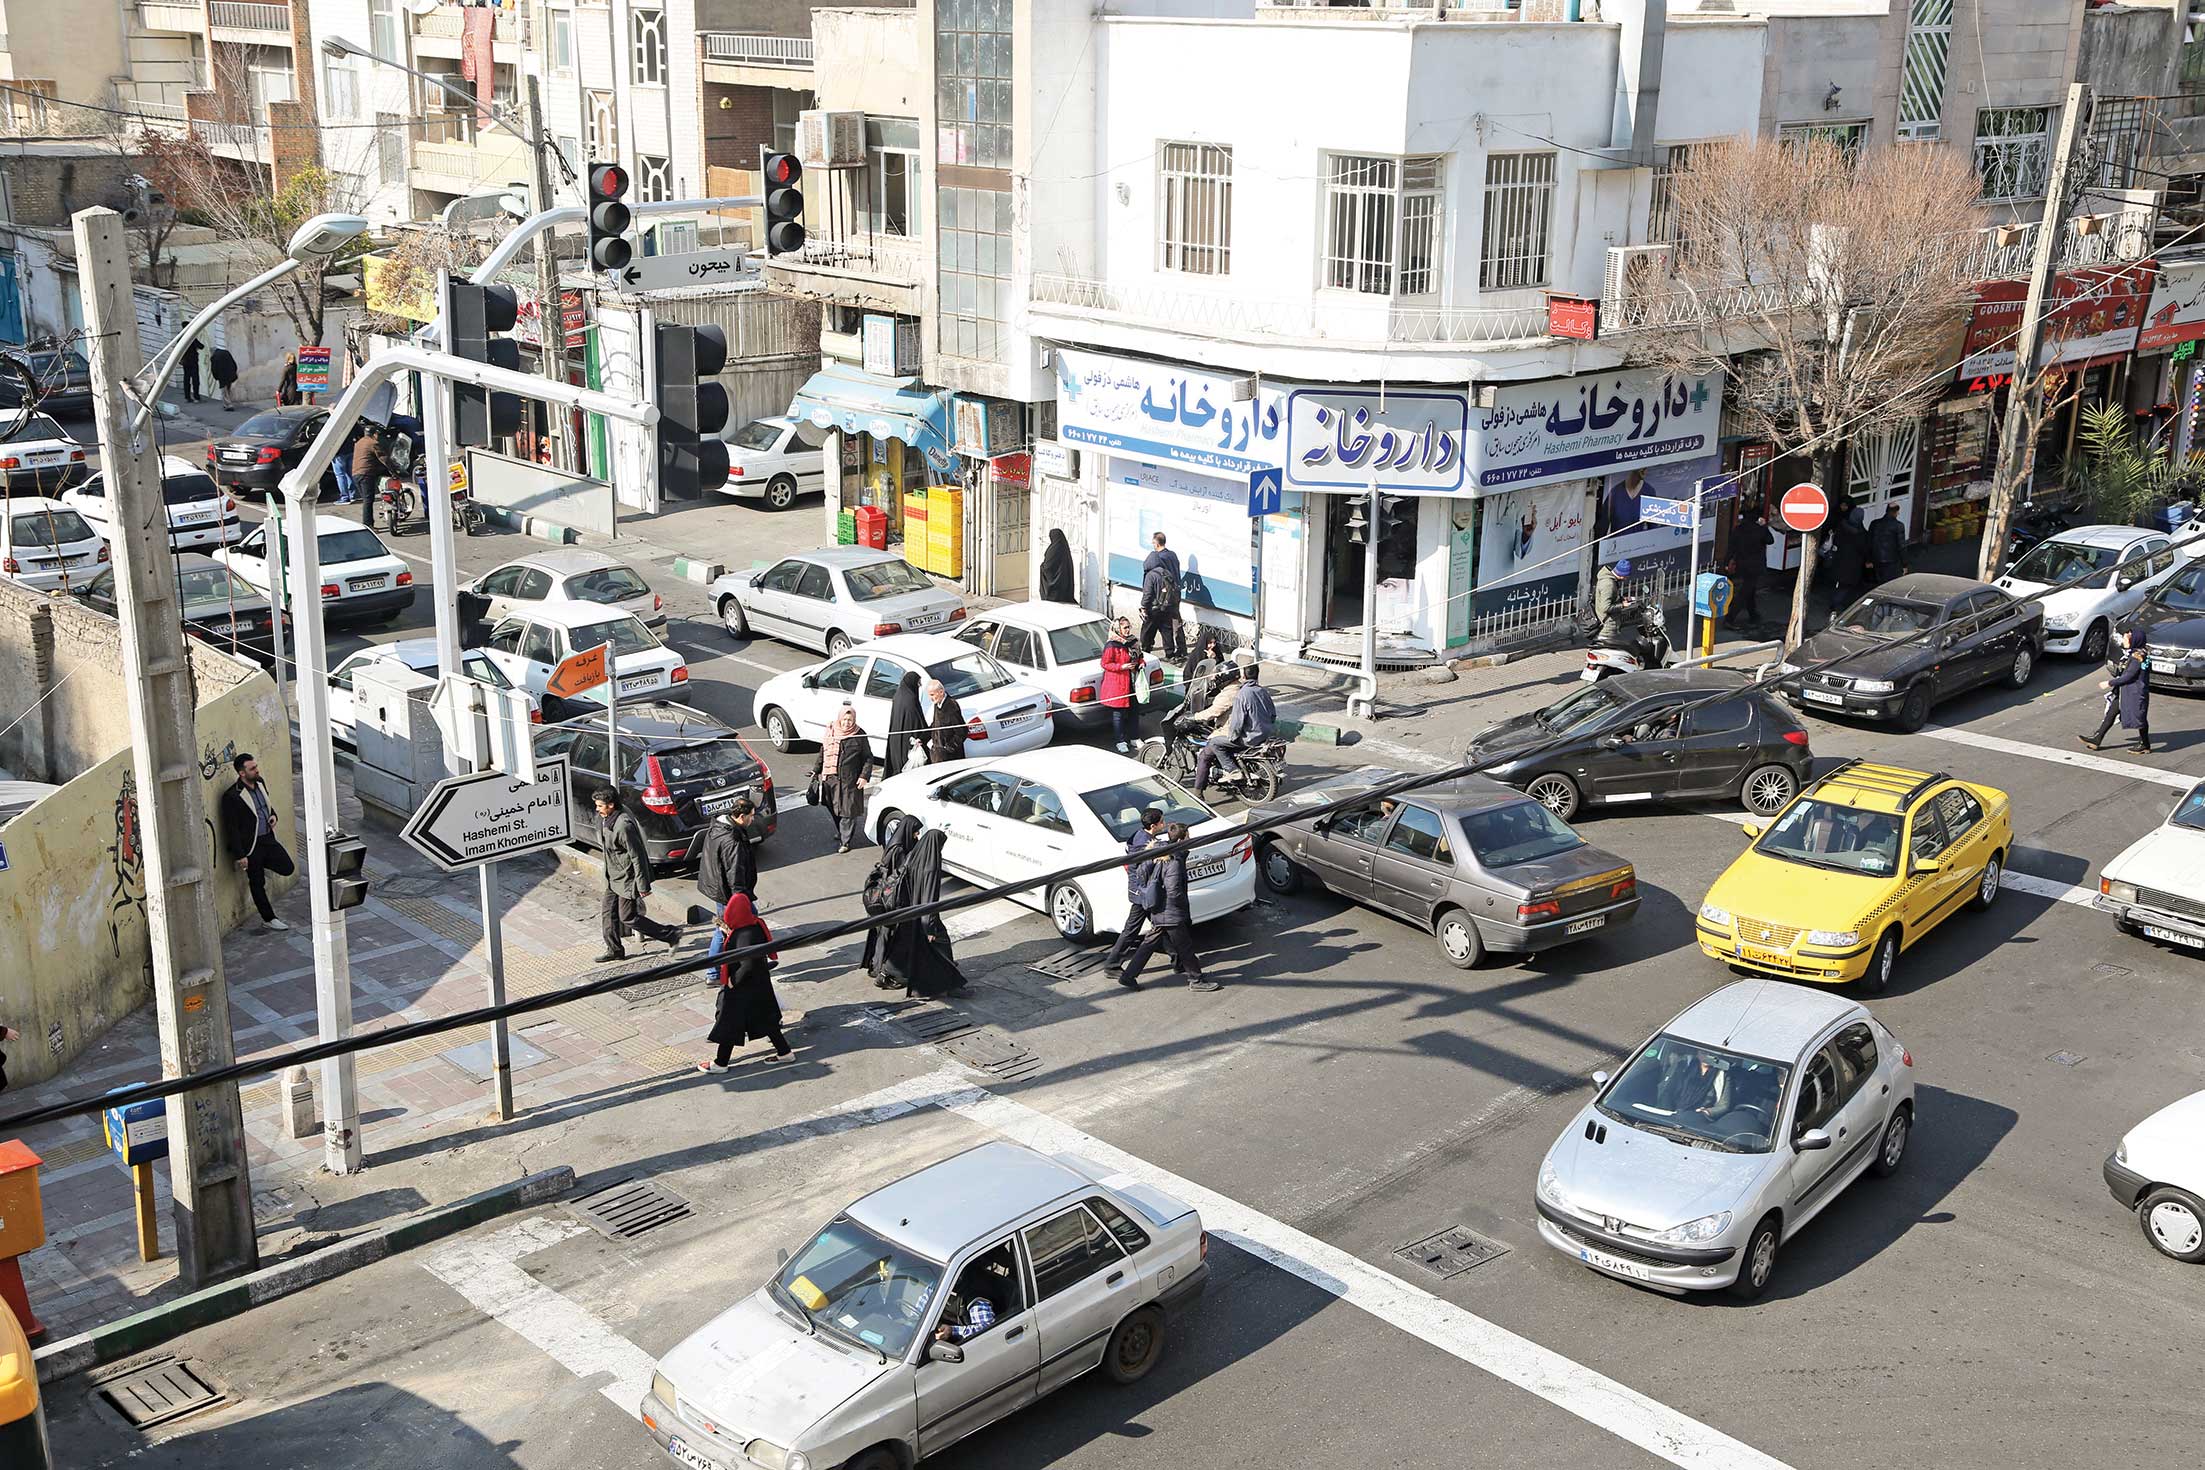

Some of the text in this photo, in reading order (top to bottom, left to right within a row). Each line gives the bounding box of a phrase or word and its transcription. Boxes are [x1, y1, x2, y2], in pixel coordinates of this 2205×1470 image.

[689, 261, 730, 278] جیحون
[1550, 318, 1592, 340] وکالت
[1084, 368, 1141, 390] هاشمی دزفولی
[1140, 378, 1279, 453] داروخانه
[1481, 401, 1547, 430] هاشمی دزفولی
[1545, 376, 1688, 440] داروخانه
[1302, 405, 1454, 468] داروخانه
[1544, 432, 1624, 455] Hashemi Pharmacy
[1685, 439, 1700, 450] طرف
[1624, 449, 1639, 460] بیمه
[1639, 445, 1654, 458] کلیه
[1661, 442, 1685, 454] قرارداد
[1637, 554, 1676, 572] داروخانه
[1507, 584, 1549, 602] داروخانه
[576, 655, 598, 667] غرفه
[575, 671, 600, 686] بازیافت
[509, 772, 550, 793] هامی
[527, 795, 551, 814] امام
[463, 818, 528, 842] Hashemi St.
[465, 825, 562, 857] Imam Khomeini St.
